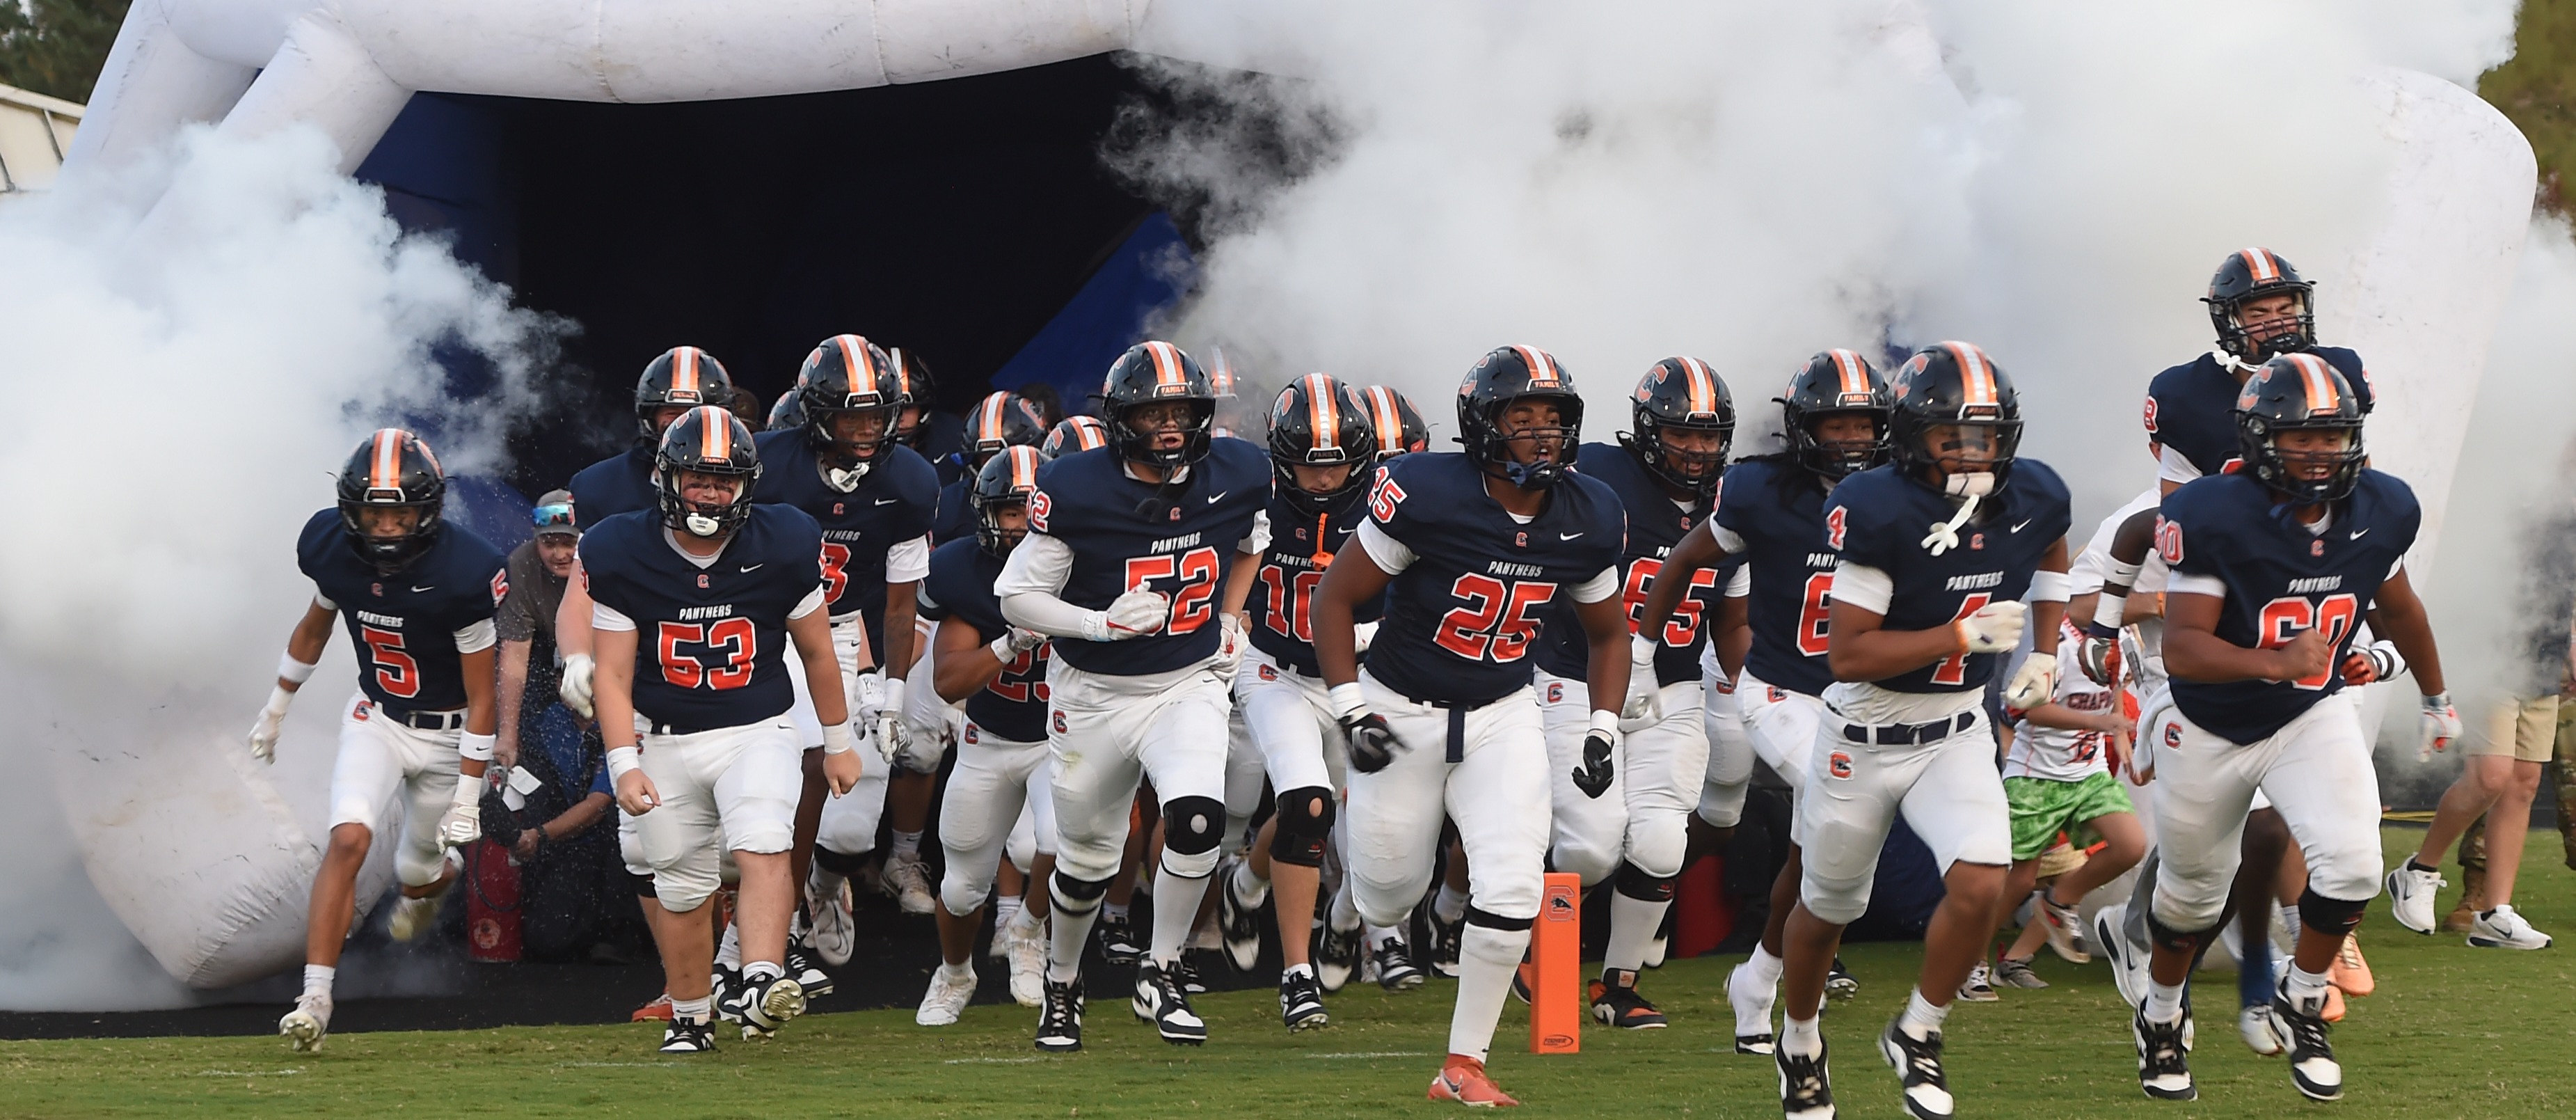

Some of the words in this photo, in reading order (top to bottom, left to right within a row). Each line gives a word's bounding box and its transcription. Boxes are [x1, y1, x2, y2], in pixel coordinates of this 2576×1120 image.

[1161, 386, 1185, 394] FAMILY
[1151, 532, 1201, 555] PANTHERS
[1826, 505, 1847, 551] 4
[1487, 560, 1543, 577] PANTHERS
[1945, 571, 2004, 591] PANTHERS
[491, 568, 510, 607] 5
[2287, 575, 2342, 594] PANTHERS
[679, 604, 732, 621] PANTHERS
[1433, 571, 1558, 663] 25
[1622, 557, 1719, 647] 65
[356, 610, 404, 627] PANTHERS
[658, 617, 757, 691] 53
[2255, 593, 2358, 691] 60
[361, 624, 420, 699] 5
